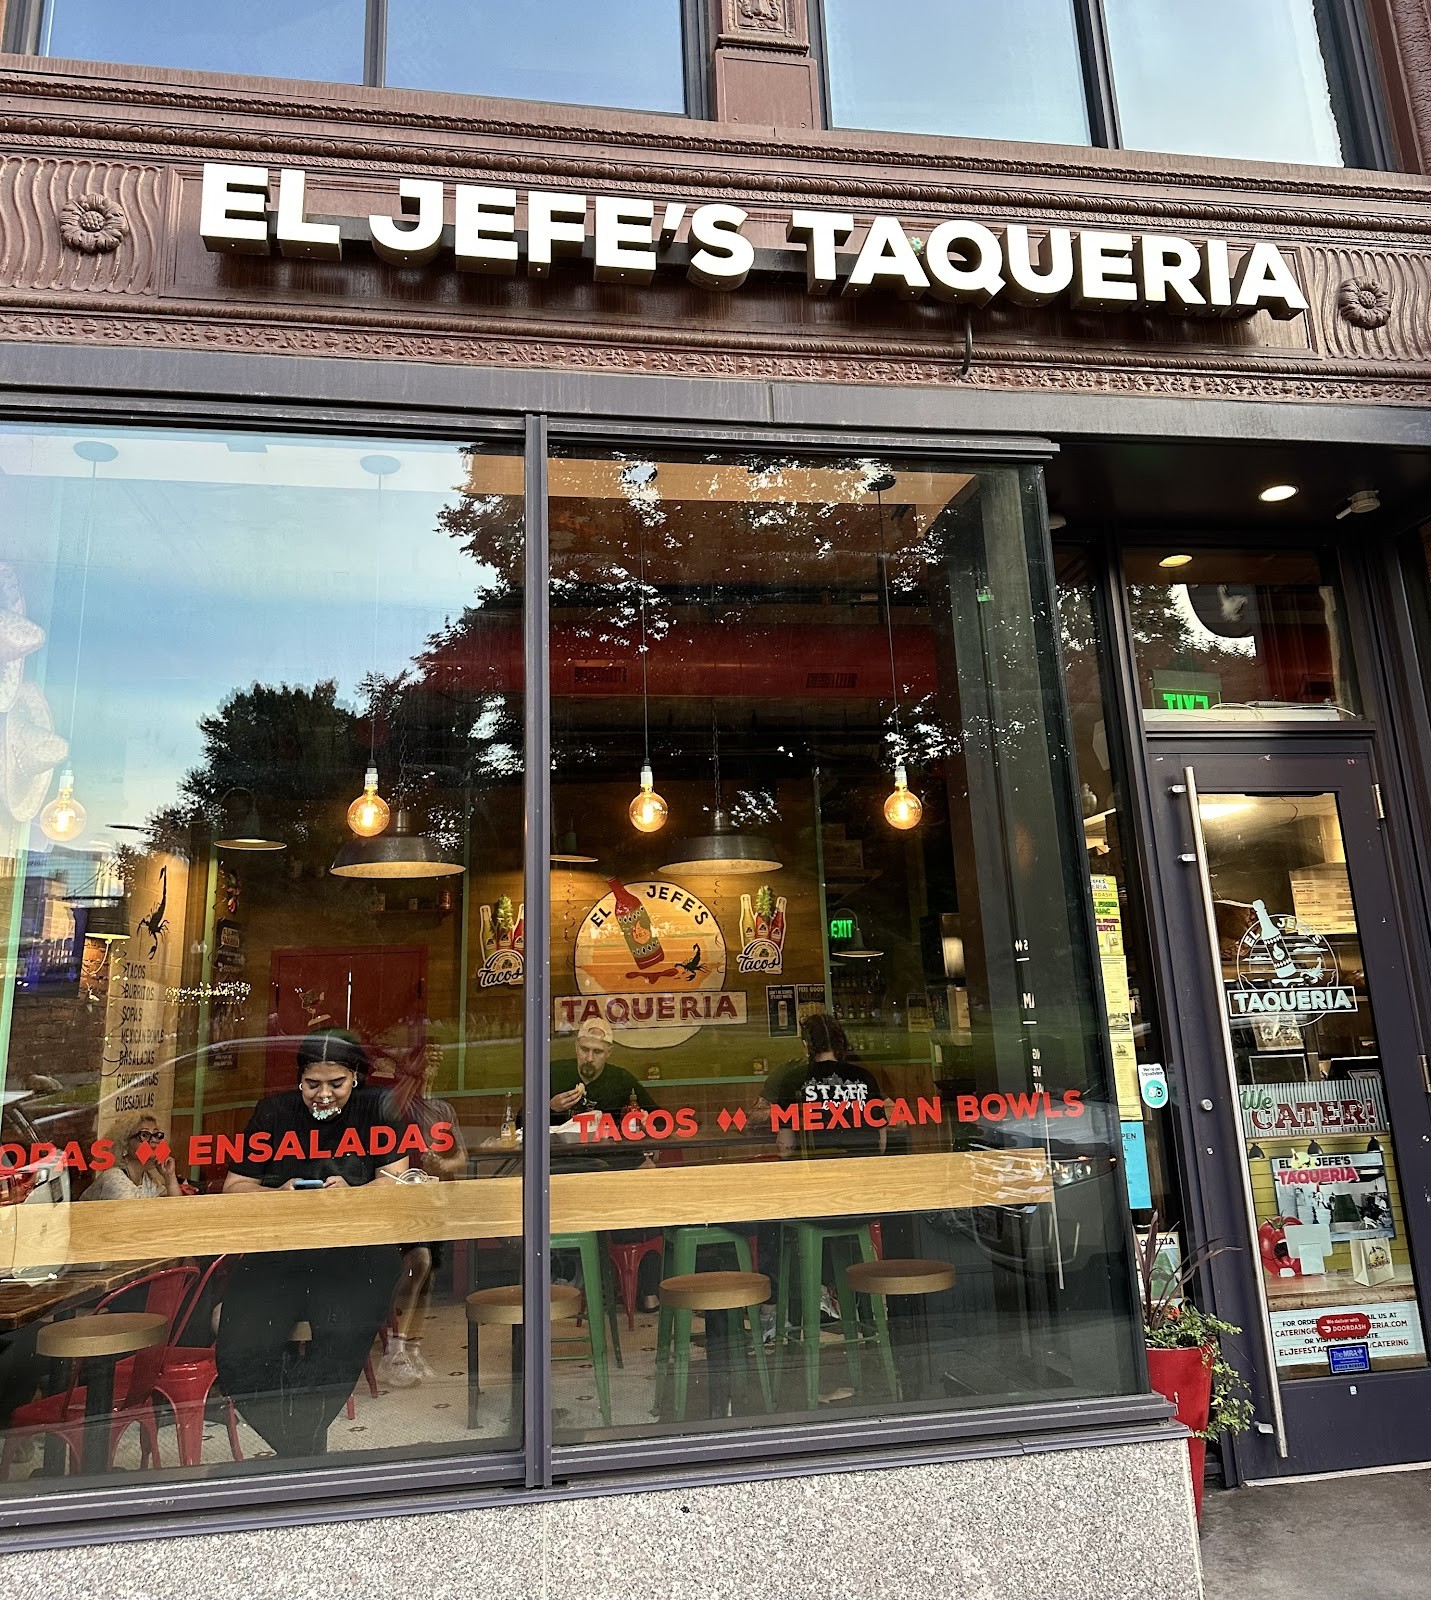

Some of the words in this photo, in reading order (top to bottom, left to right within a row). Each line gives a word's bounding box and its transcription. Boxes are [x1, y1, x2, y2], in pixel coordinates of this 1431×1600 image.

[200, 163, 341, 246] EL
[369, 178, 754, 277] JEFE'S
[793, 209, 1309, 311] TAQUERIA
[590, 907, 612, 928] EL
[646, 885, 709, 925] JEFE'S
[830, 919, 853, 937] EXIT
[1243, 928, 1261, 948] EL
[127, 962, 146, 980] TACOS
[738, 955, 781, 972] Tacos
[479, 967, 524, 986] Tacos
[561, 995, 738, 1025] TAQUERIA
[1233, 989, 1353, 1013] TAQUERIA
[805, 1083, 868, 1101] STAFF
[1240, 1088, 1274, 1111] We
[115, 1093, 155, 1112] QUESADILLAS
[770, 1096, 942, 1133] MEXICAN
[957, 1089, 1085, 1123] BOWLS
[1251, 1098, 1378, 1131] CATER!
[572, 1107, 699, 1144] TACOS
[188, 1121, 455, 1167] ENSALADAS
[1279, 1159, 1291, 1169] EL
[1314, 1156, 1351, 1167] JEFE'S
[1276, 1167, 1360, 1186] TAQUERIA
[1332, 1324, 1367, 1332] DOORDASH
